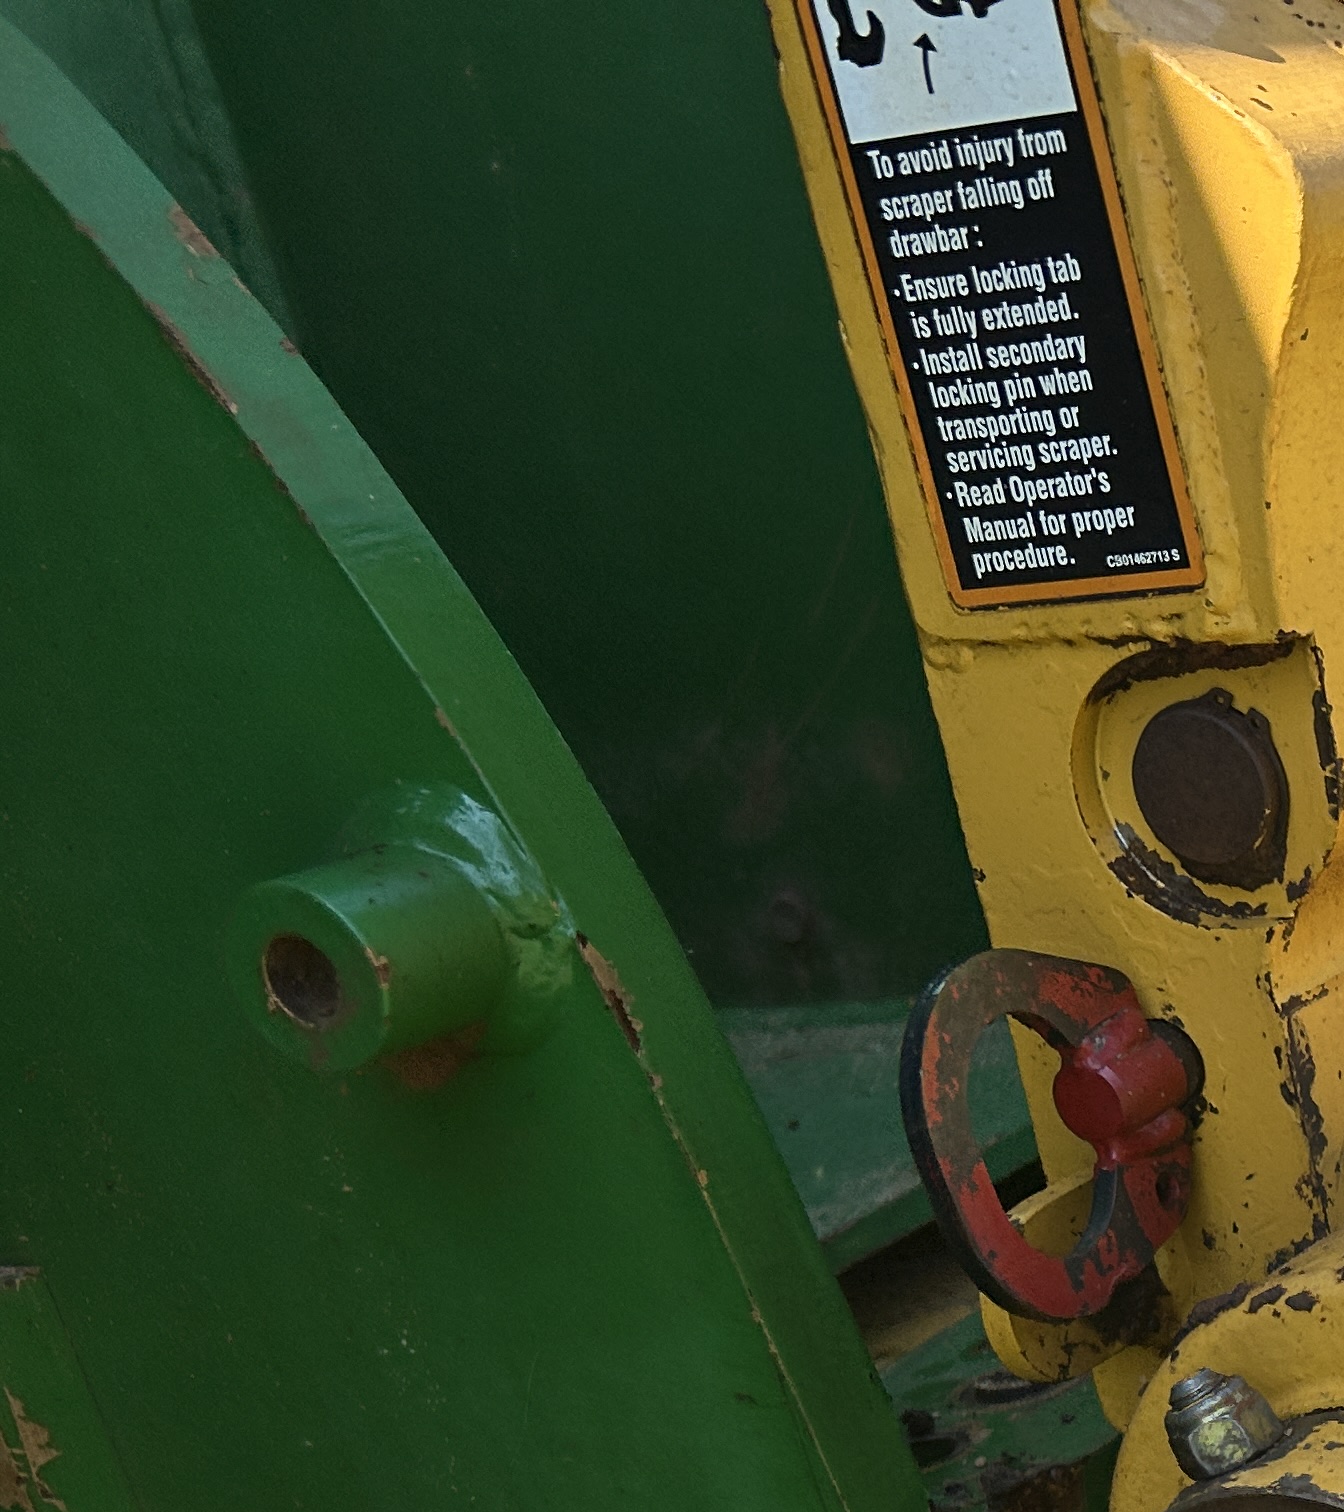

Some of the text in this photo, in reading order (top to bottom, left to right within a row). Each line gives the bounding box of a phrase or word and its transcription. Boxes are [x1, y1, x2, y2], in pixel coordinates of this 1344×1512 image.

[867, 128, 1067, 179] To avoid injury from
[881, 169, 1054, 221] scraper falling off
[890, 224, 968, 258] drawbar
[900, 253, 1081, 302] Ensure locking tab
[910, 293, 1079, 339] is fully extended.
[920, 334, 1085, 375] Install secondary
[929, 368, 1093, 408] locking pin when
[937, 406, 1079, 443] transporting or
[947, 435, 1117, 472] servicing scraper.
[954, 468, 1110, 507] Read Operator's
[963, 507, 1134, 543] Manual for proper
[973, 543, 1075, 579] procedure.
